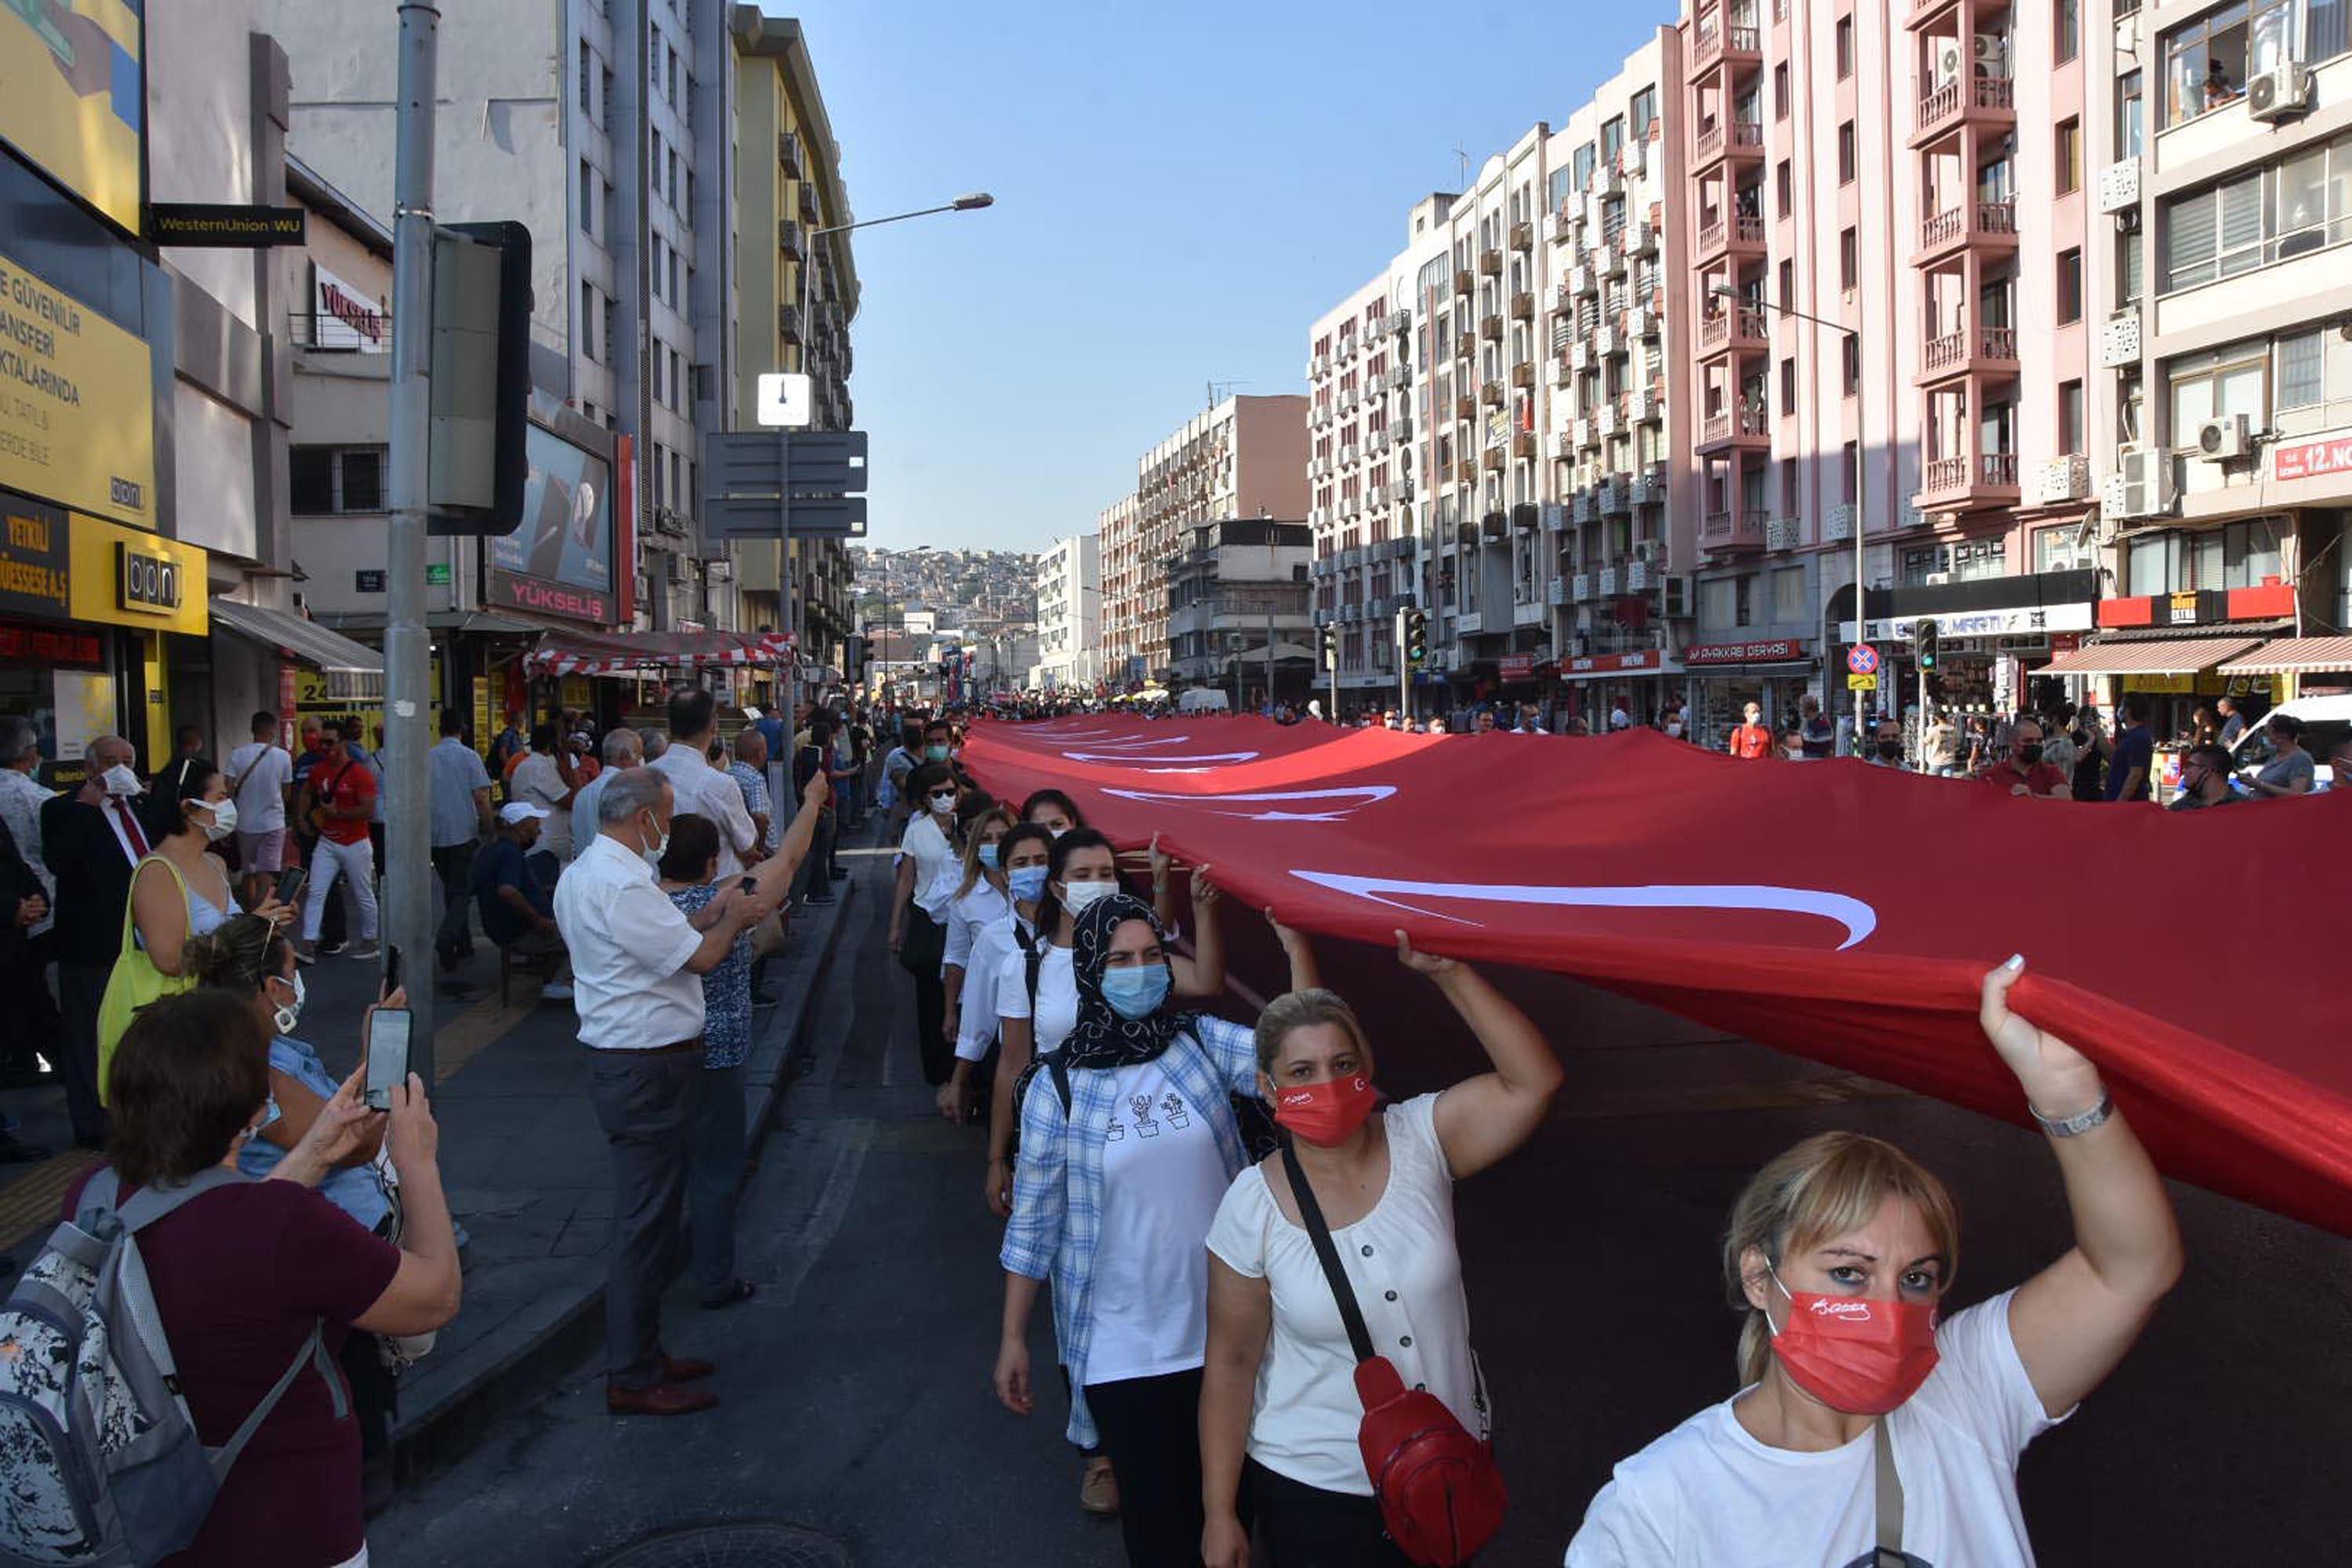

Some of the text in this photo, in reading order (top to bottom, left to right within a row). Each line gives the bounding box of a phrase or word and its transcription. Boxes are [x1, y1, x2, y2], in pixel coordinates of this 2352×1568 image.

[161, 218, 301, 232] WesternUnion WU
[13, 277, 80, 337] GÜVENİLİR
[131, 554, 173, 603] bpn
[511, 580, 602, 621] YÜKSELİŞ
